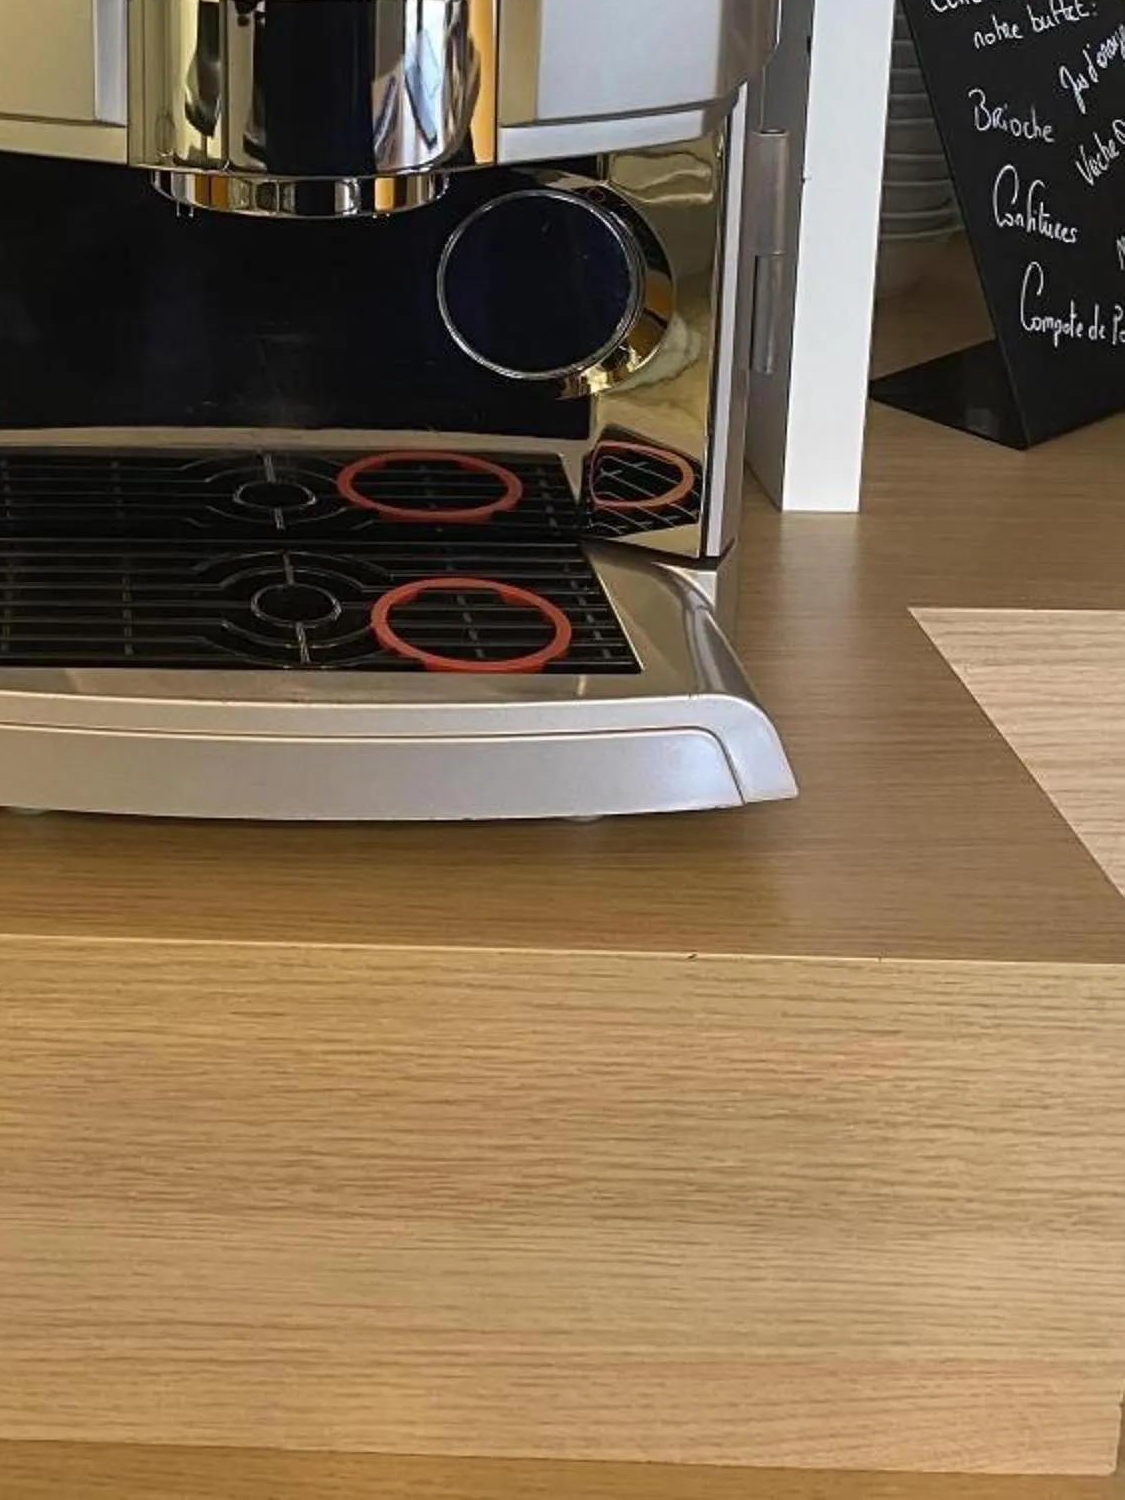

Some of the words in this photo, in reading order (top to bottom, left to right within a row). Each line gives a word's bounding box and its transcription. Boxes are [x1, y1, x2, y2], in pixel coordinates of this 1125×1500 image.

[968, 88, 1054, 143] Brioche
[1075, 130, 1120, 186] Vache
[1020, 261, 1083, 348] Compote
[1088, 303, 1106, 340] de
